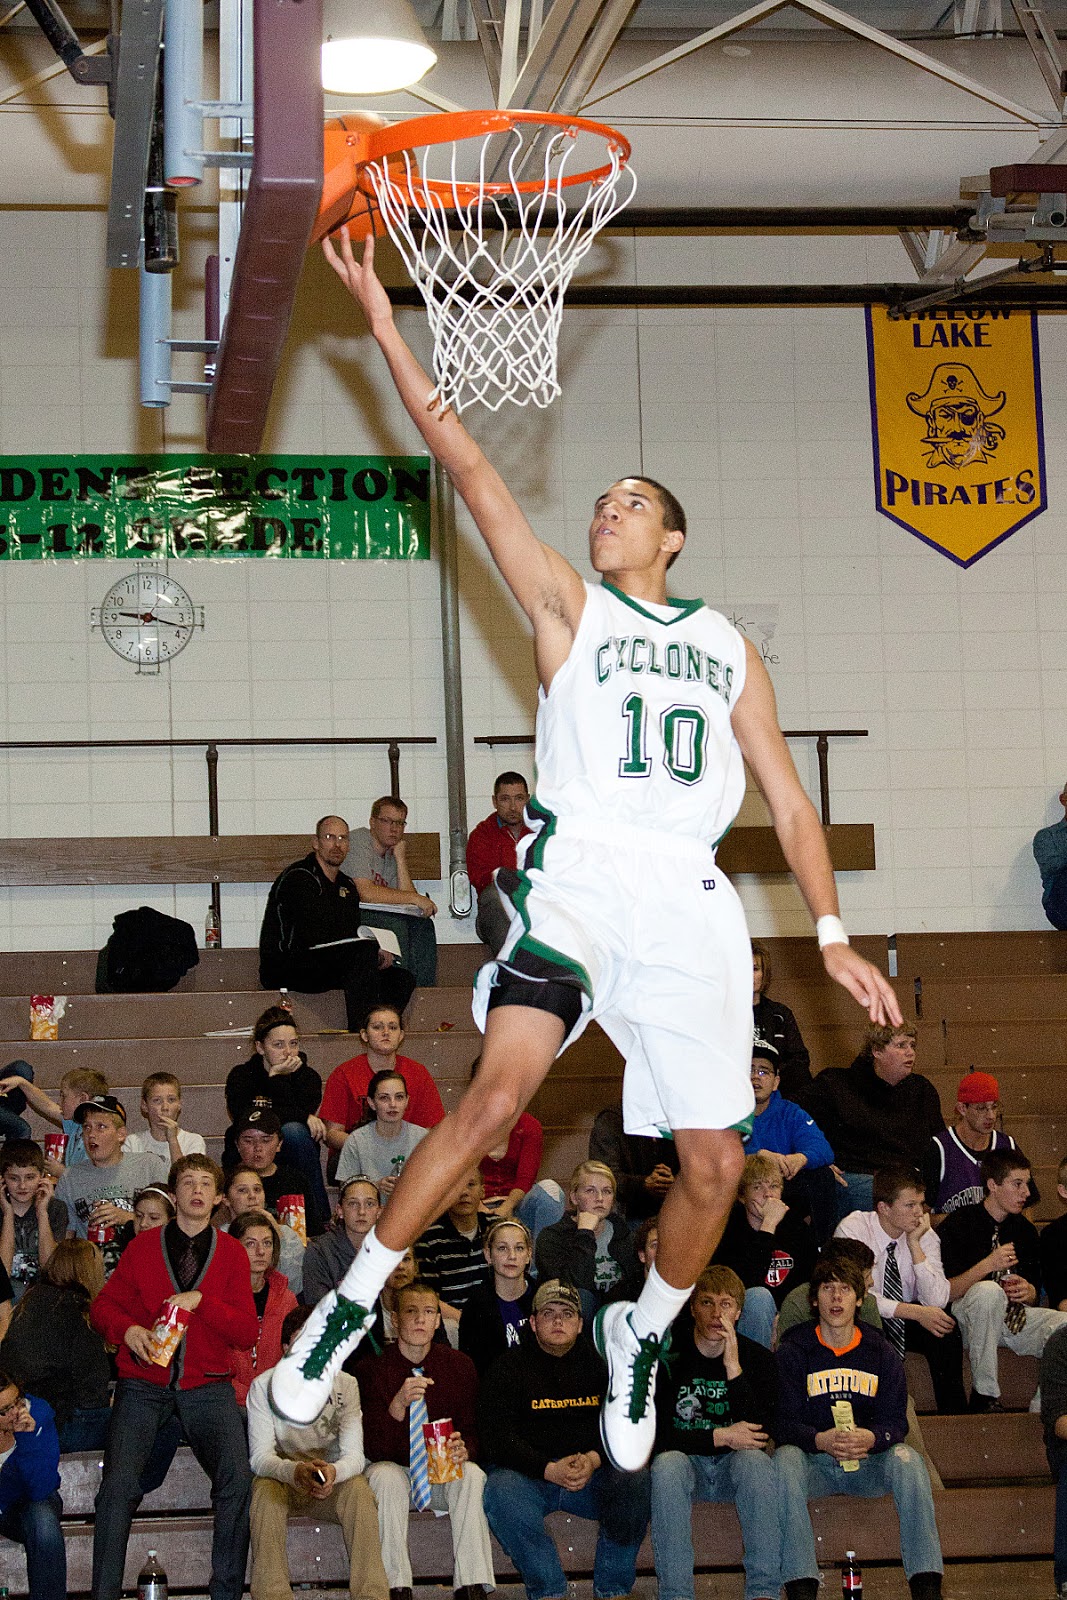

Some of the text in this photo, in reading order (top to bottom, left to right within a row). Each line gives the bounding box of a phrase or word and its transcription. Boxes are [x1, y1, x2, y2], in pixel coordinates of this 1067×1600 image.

[912, 322, 992, 348] LAKE
[885, 468, 1036, 506] PIRATES
[127, 585, 135, 594] 11
[142, 580, 152, 590] 12
[113, 597, 124, 607] 10
[174, 597, 180, 606] 2
[111, 614, 118, 622] 9
[179, 613, 184, 622] 3
[116, 630, 122, 639] 8
[175, 630, 181, 638] 4
[128, 642, 134, 651] 7
[162, 642, 168, 651] 5
[145, 647, 151, 656] 6
[594, 635, 734, 704] CYCLONES
[618, 692, 709, 786] 10
[806, 1368, 879, 1398] ATETOWN
[531, 1396, 599, 1409] CATERPILLAR
